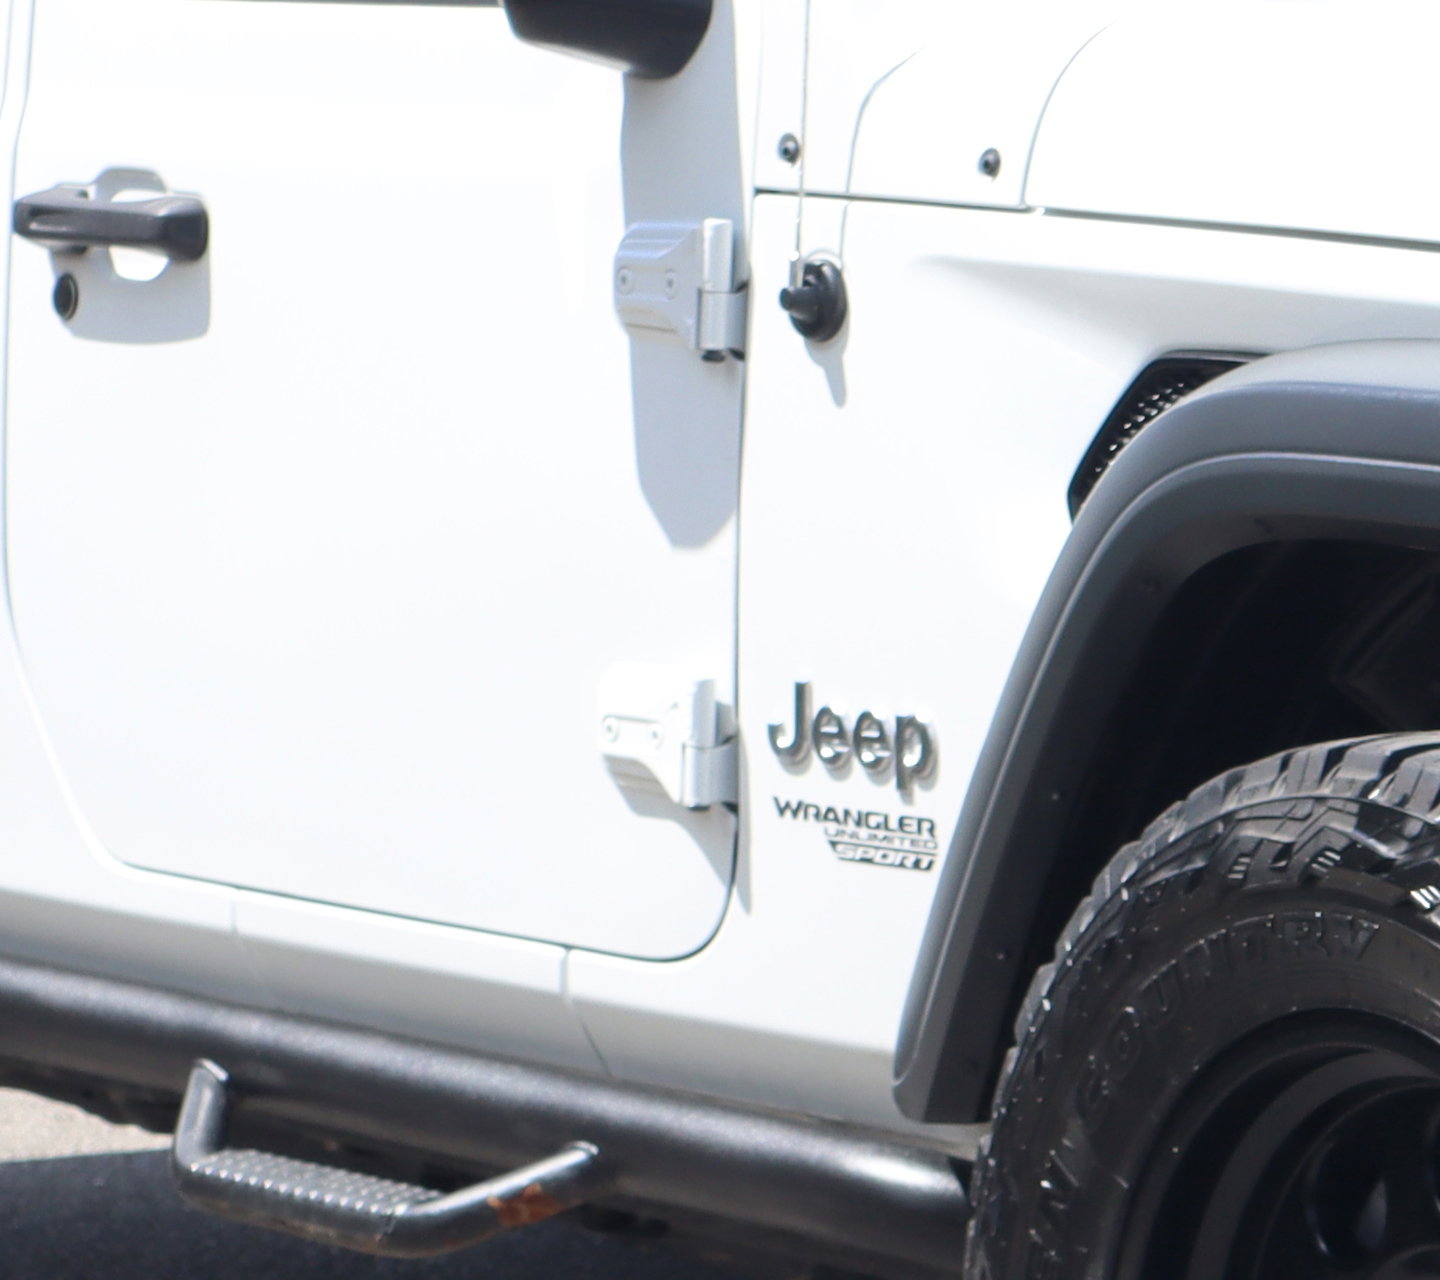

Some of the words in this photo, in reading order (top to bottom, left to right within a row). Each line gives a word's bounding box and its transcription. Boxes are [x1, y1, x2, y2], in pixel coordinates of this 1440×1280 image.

[766, 680, 937, 792] Jeep
[772, 795, 937, 839] WRANGLER
[823, 825, 939, 851] UNLIMITED
[832, 842, 934, 872] SPORT
